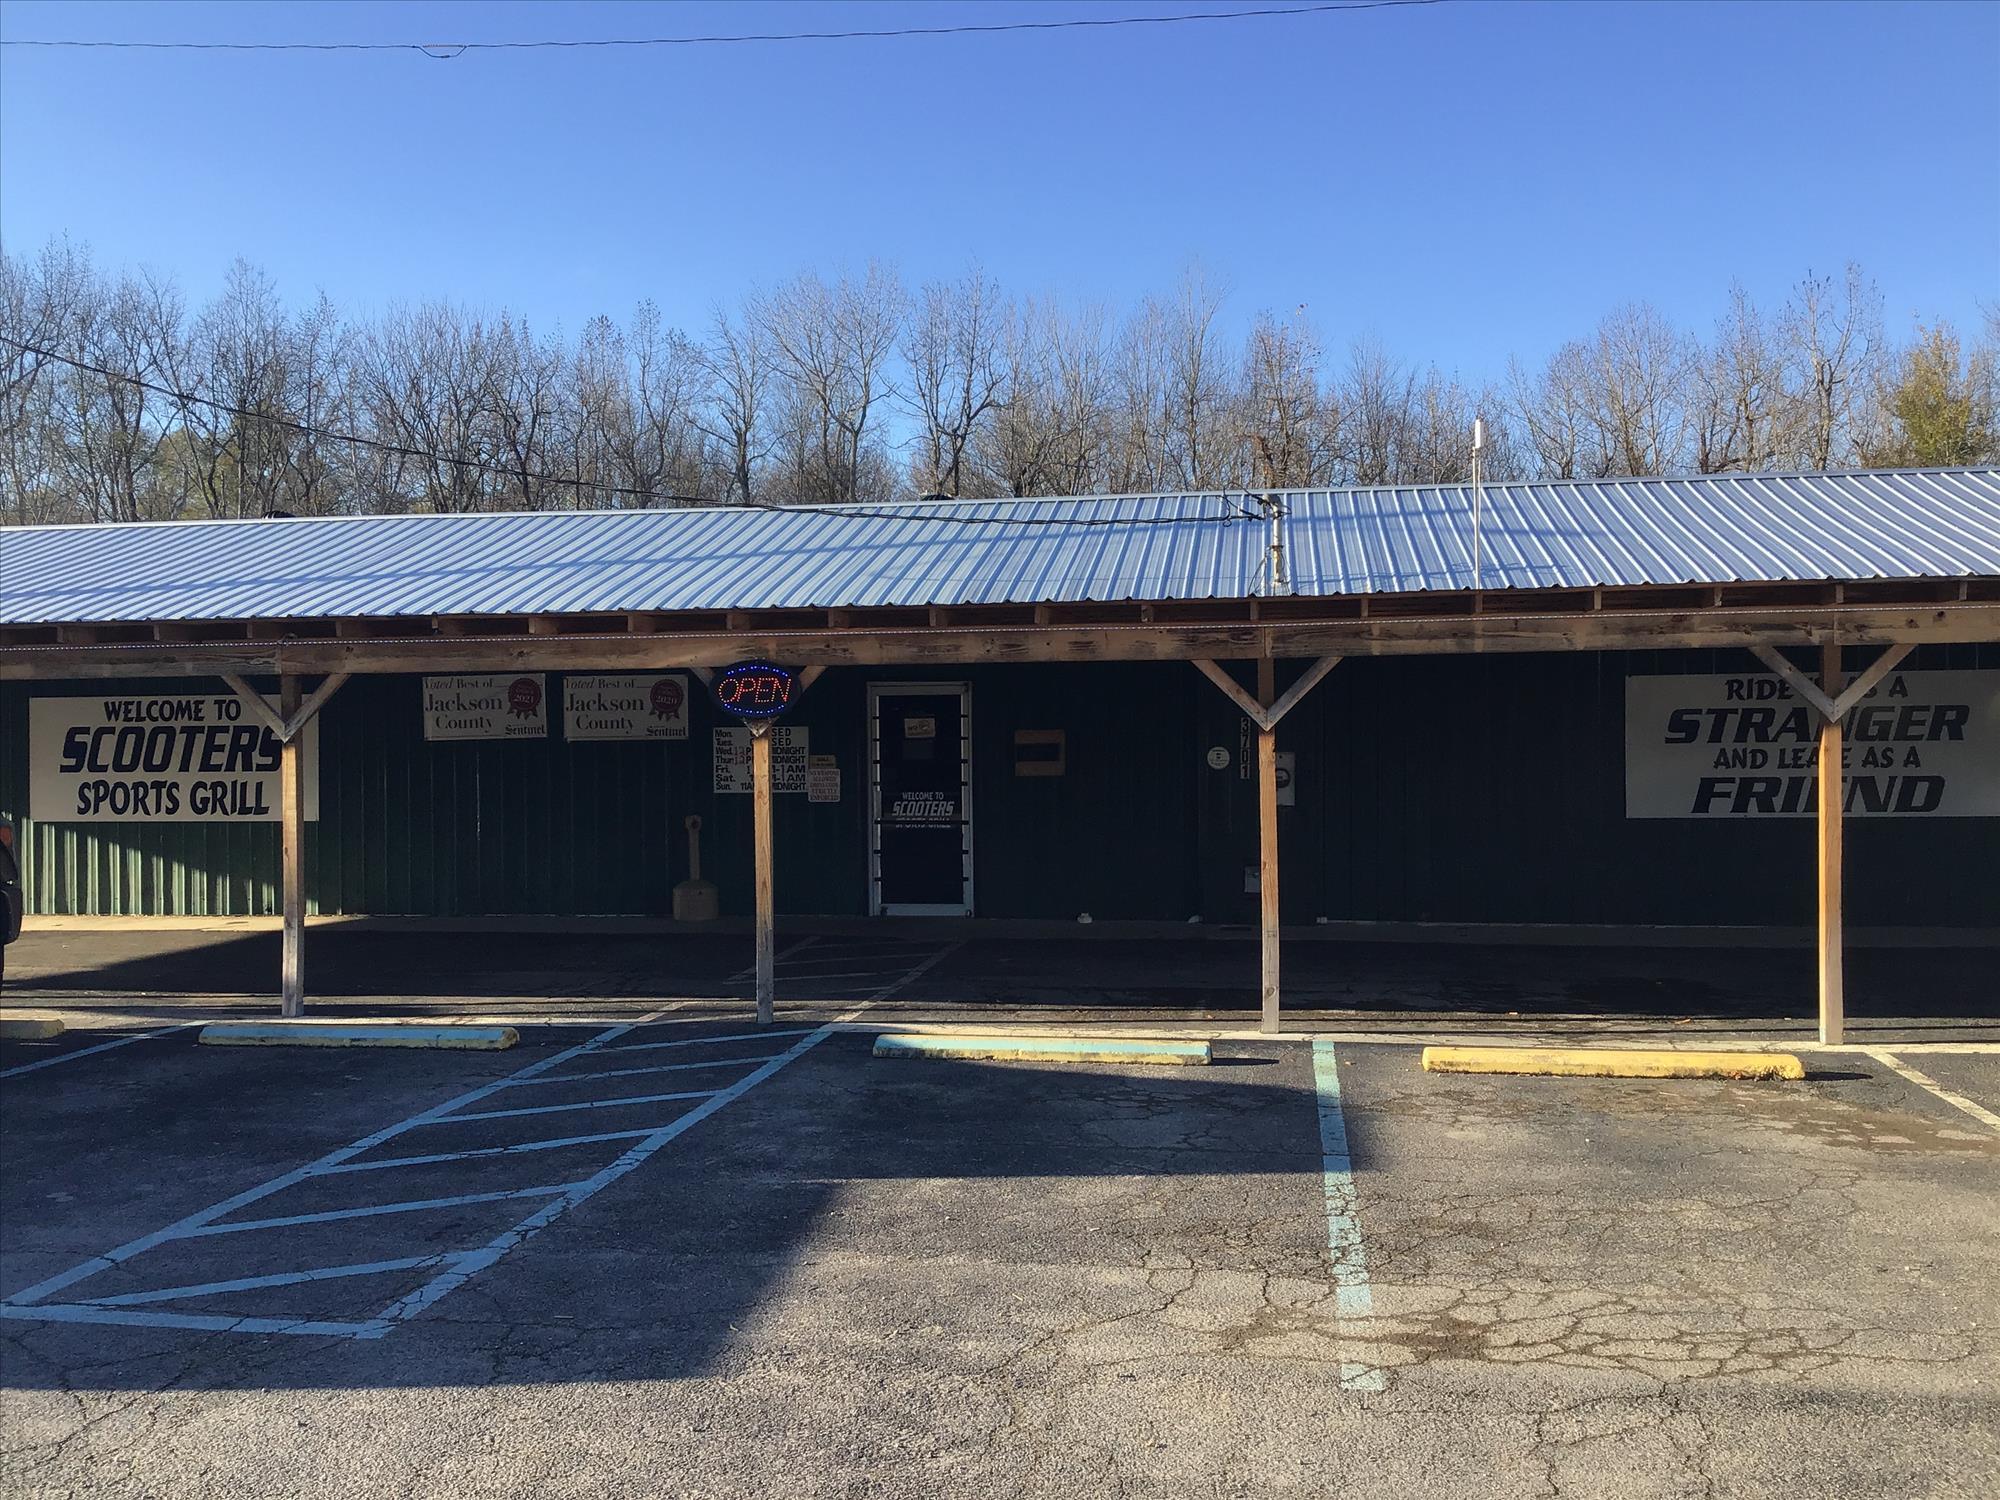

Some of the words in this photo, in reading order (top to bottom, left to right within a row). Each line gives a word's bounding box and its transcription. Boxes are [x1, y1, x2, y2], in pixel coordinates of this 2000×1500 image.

[424, 677, 454, 689] Voted
[457, 679, 479, 689] Best
[483, 678, 494, 688] of
[565, 677, 595, 689] Voted
[598, 678, 620, 689] Best
[624, 678, 636, 688] of
[718, 677, 792, 703] OPEN
[1725, 677, 1795, 701] RIDE
[104, 699, 205, 722] WELCOME
[214, 699, 241, 721] TO
[425, 691, 503, 713] Jackson
[566, 692, 645, 713] Jackson
[436, 714, 493, 733] County
[505, 724, 545, 736] Sentinel
[576, 714, 634, 734] County
[646, 726, 687, 737] Sentinel
[60, 725, 282, 773] SCOOTERS
[1241, 718, 1249, 778] 3701
[1713, 747, 1768, 770] AND
[1777, 747, 1852, 770] LEAE
[1862, 746, 1894, 769] AS
[1903, 746, 1921, 768] A
[77, 780, 180, 816] SPORTS
[190, 780, 270, 816] GRILL
[902, 792, 933, 800] WELCOME
[935, 792, 945, 800] TO
[892, 801, 954, 816] SCOOTERS
